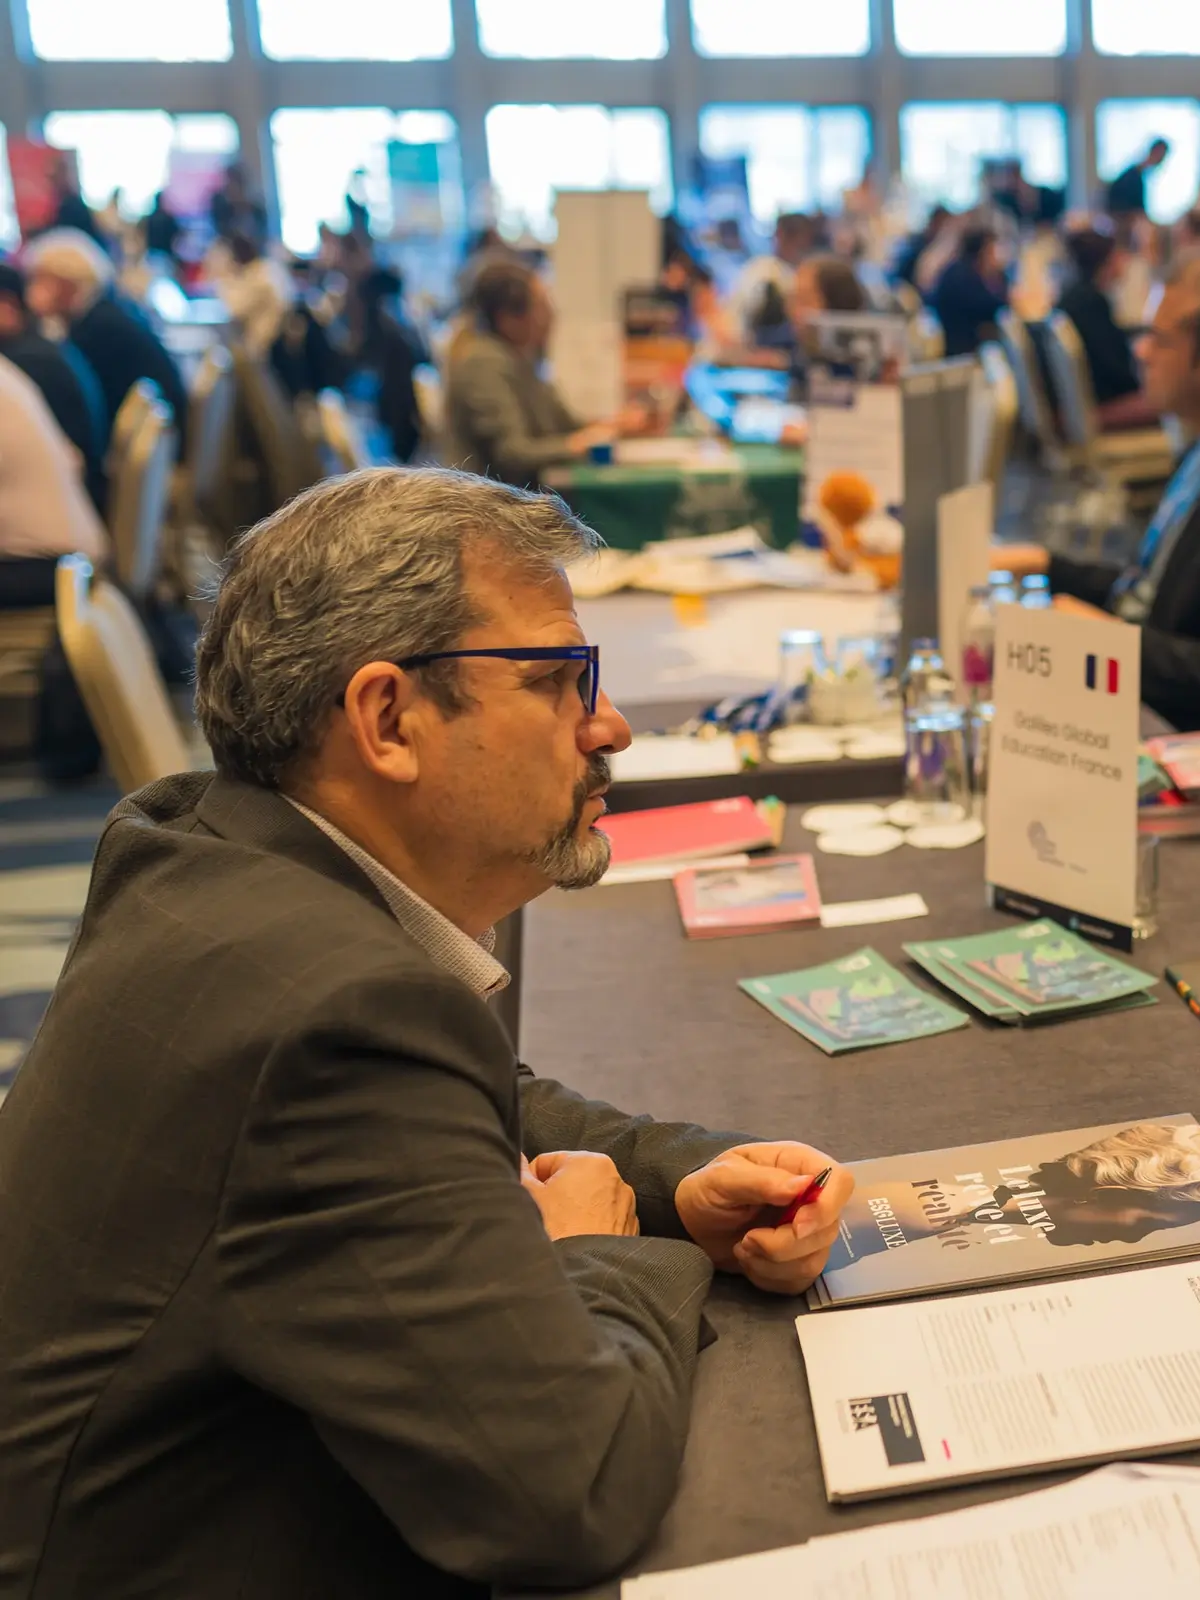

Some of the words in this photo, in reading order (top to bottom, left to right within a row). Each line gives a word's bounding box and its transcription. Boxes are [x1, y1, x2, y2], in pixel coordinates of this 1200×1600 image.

[1007, 641, 1052, 677] H05
[1061, 724, 1109, 750] Global
[1002, 735, 1069, 767] Education
[1070, 752, 1121, 781] France
[983, 1223, 1028, 1245] et
